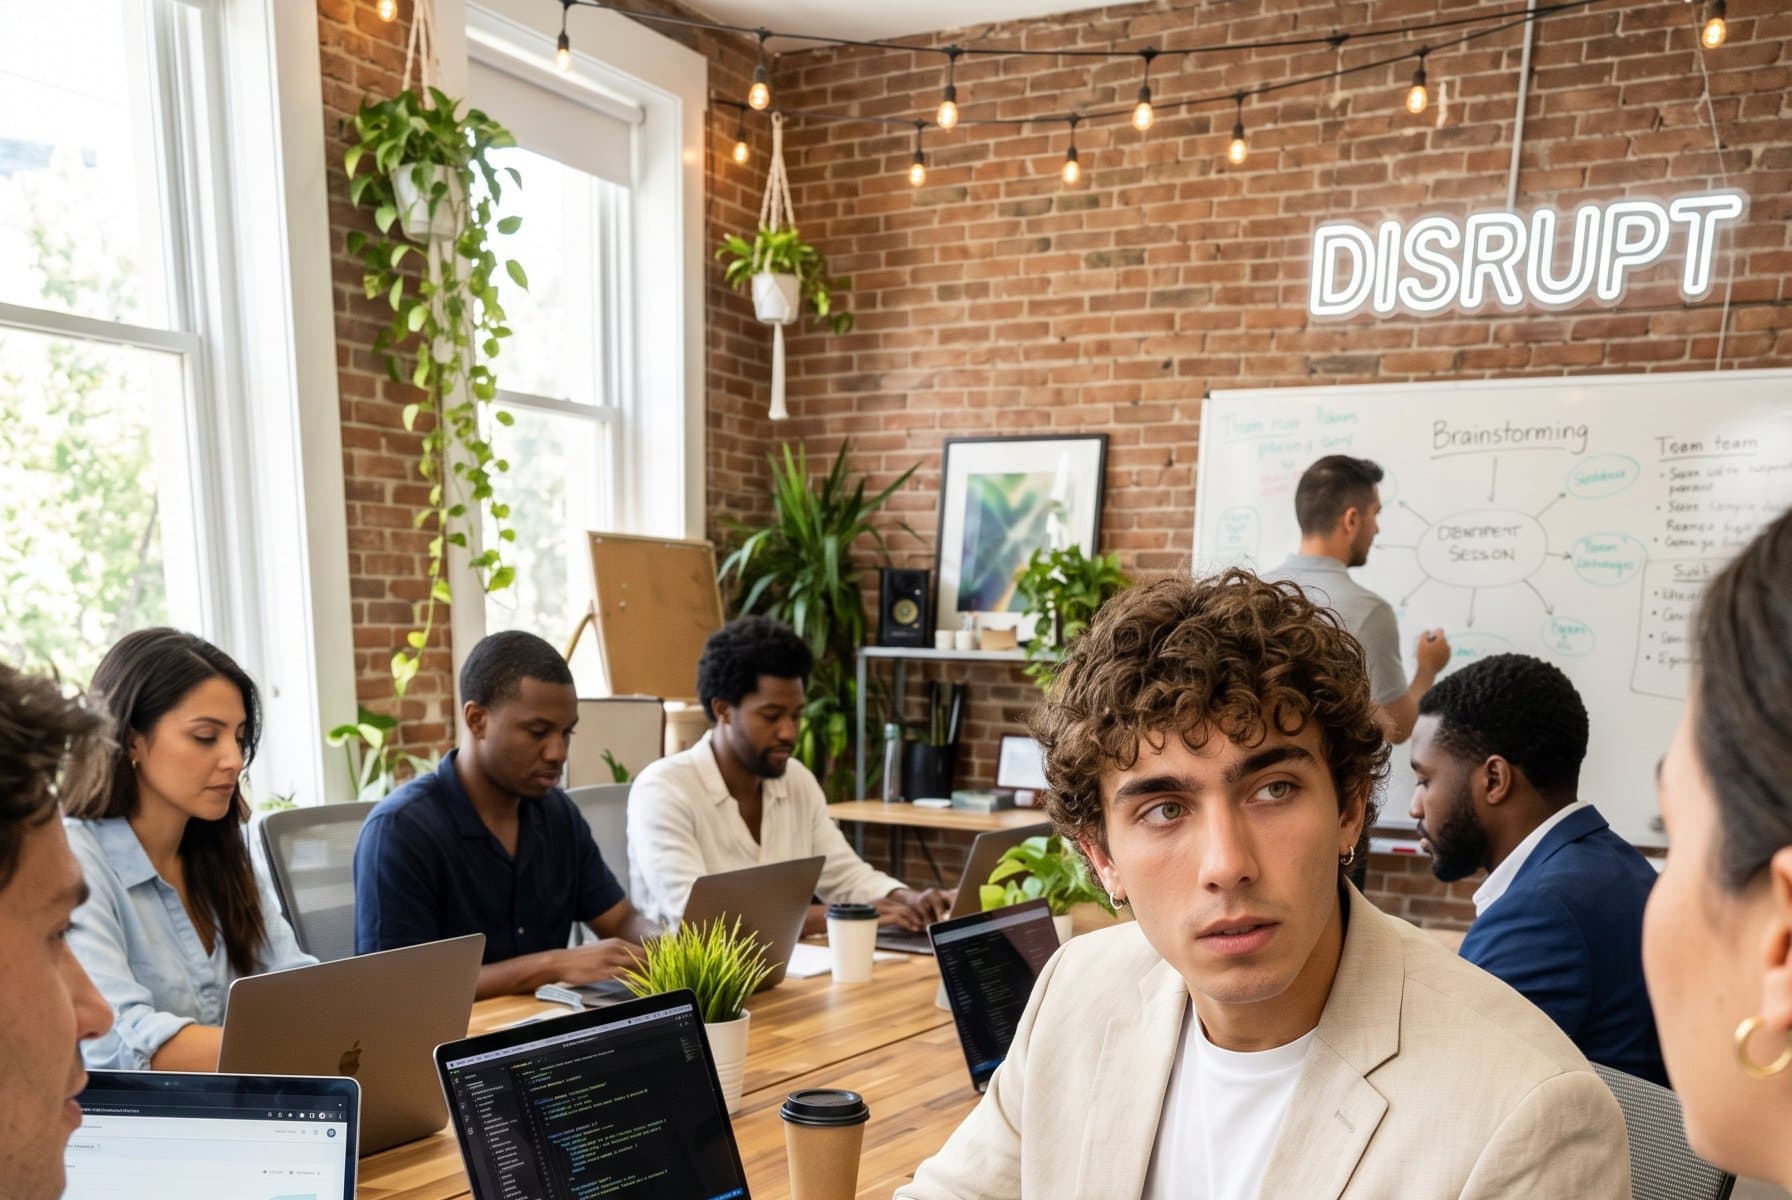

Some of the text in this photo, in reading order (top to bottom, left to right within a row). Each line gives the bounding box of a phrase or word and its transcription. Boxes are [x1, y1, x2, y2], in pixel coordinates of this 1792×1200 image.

[1309, 193, 1743, 316] DISRUPT
[1432, 419, 1590, 456] Brainstorming
[1714, 434, 1758, 450] team
